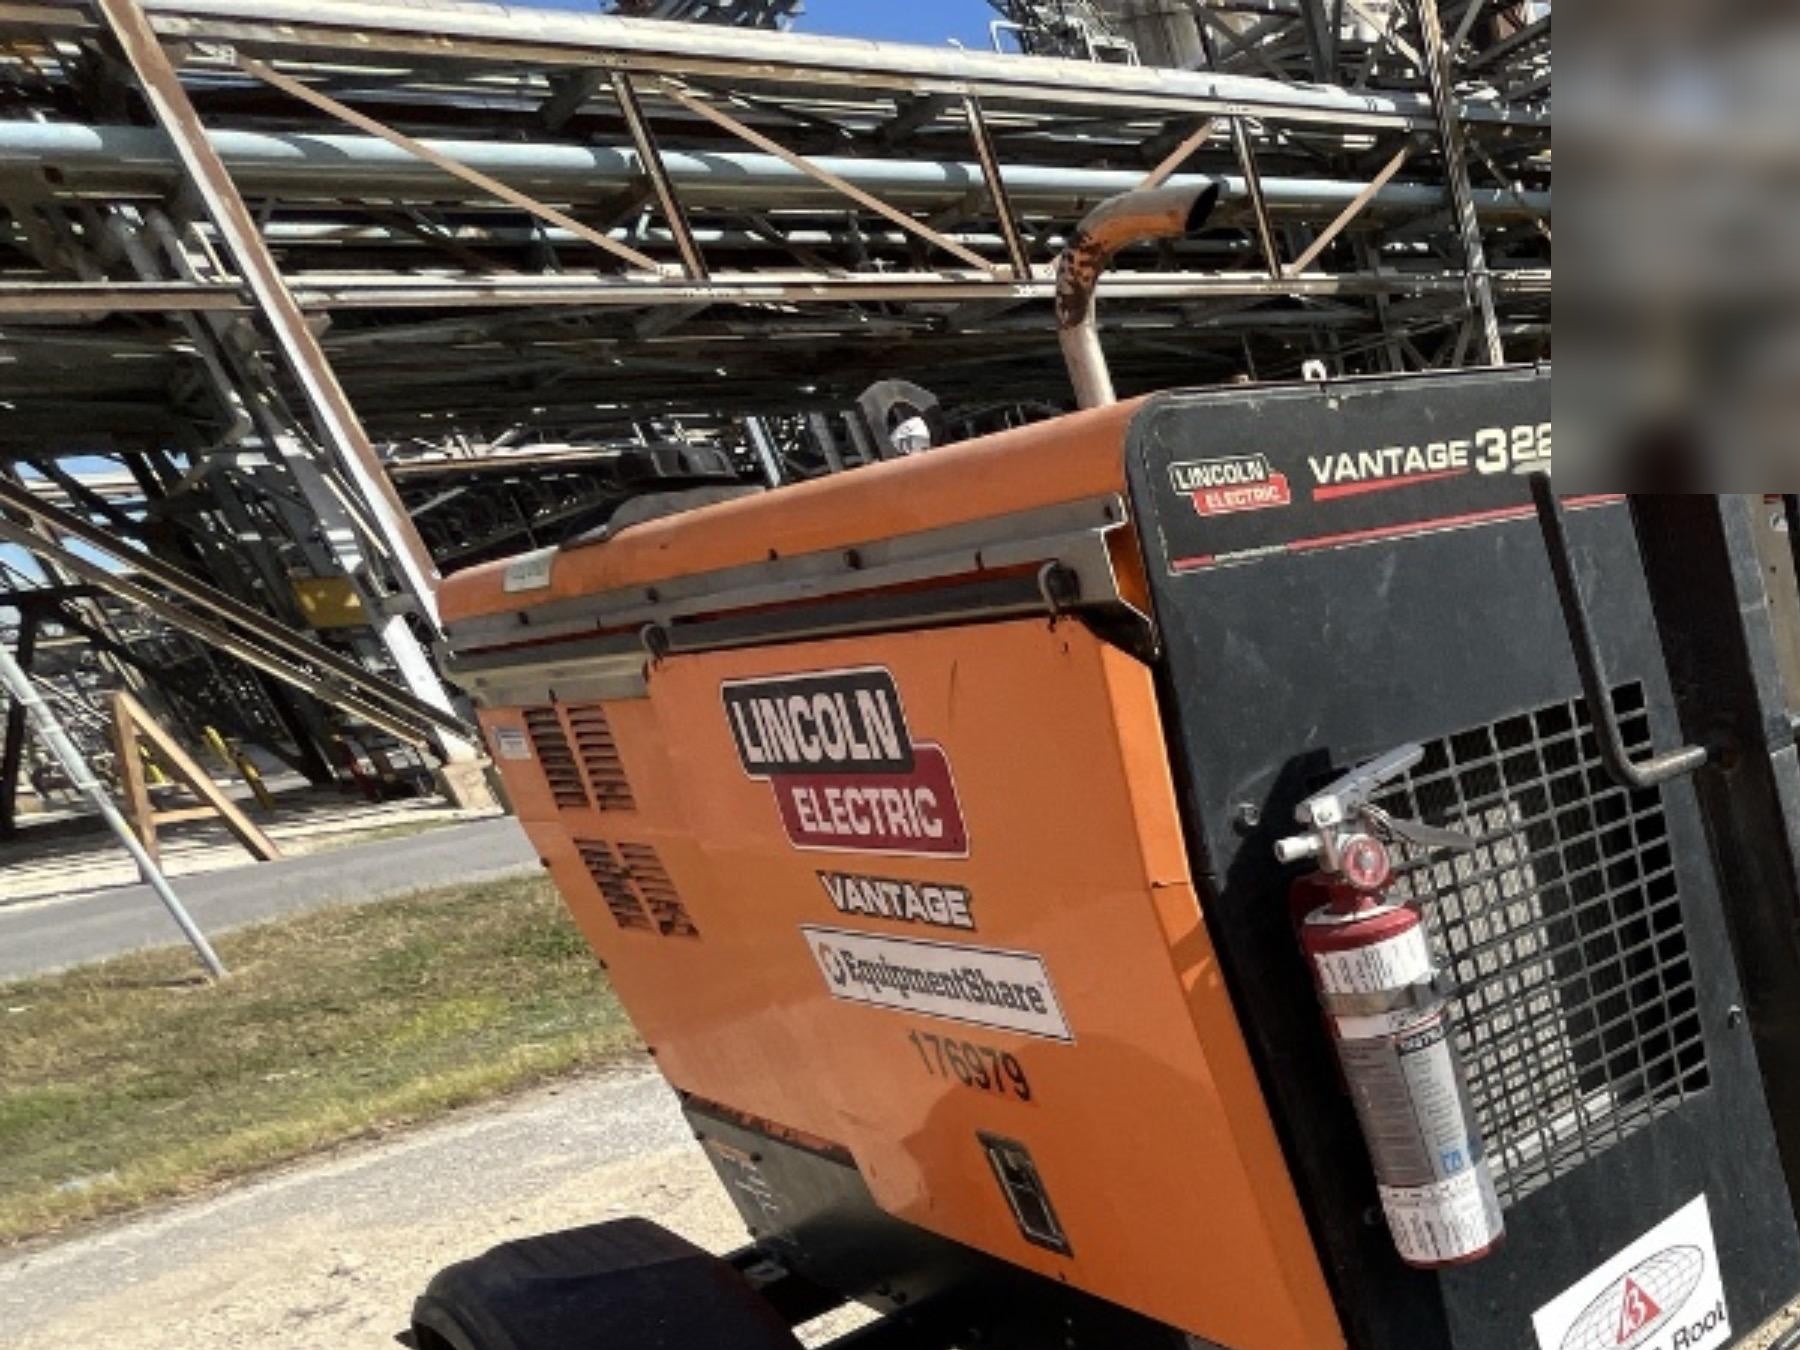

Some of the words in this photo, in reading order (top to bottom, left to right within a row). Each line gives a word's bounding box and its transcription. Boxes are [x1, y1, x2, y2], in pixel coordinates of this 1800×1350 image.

[1174, 461, 1265, 489] LINCOLN
[1308, 440, 1471, 484] VANTAGE
[1204, 486, 1282, 508] ELECTRIC
[732, 689, 903, 763] LINCOLN
[791, 787, 943, 839] ELECTRIC
[818, 874, 973, 927] VANTAGE
[838, 950, 1048, 1014] EquipmentShare
[908, 1030, 1031, 1102] 176979
